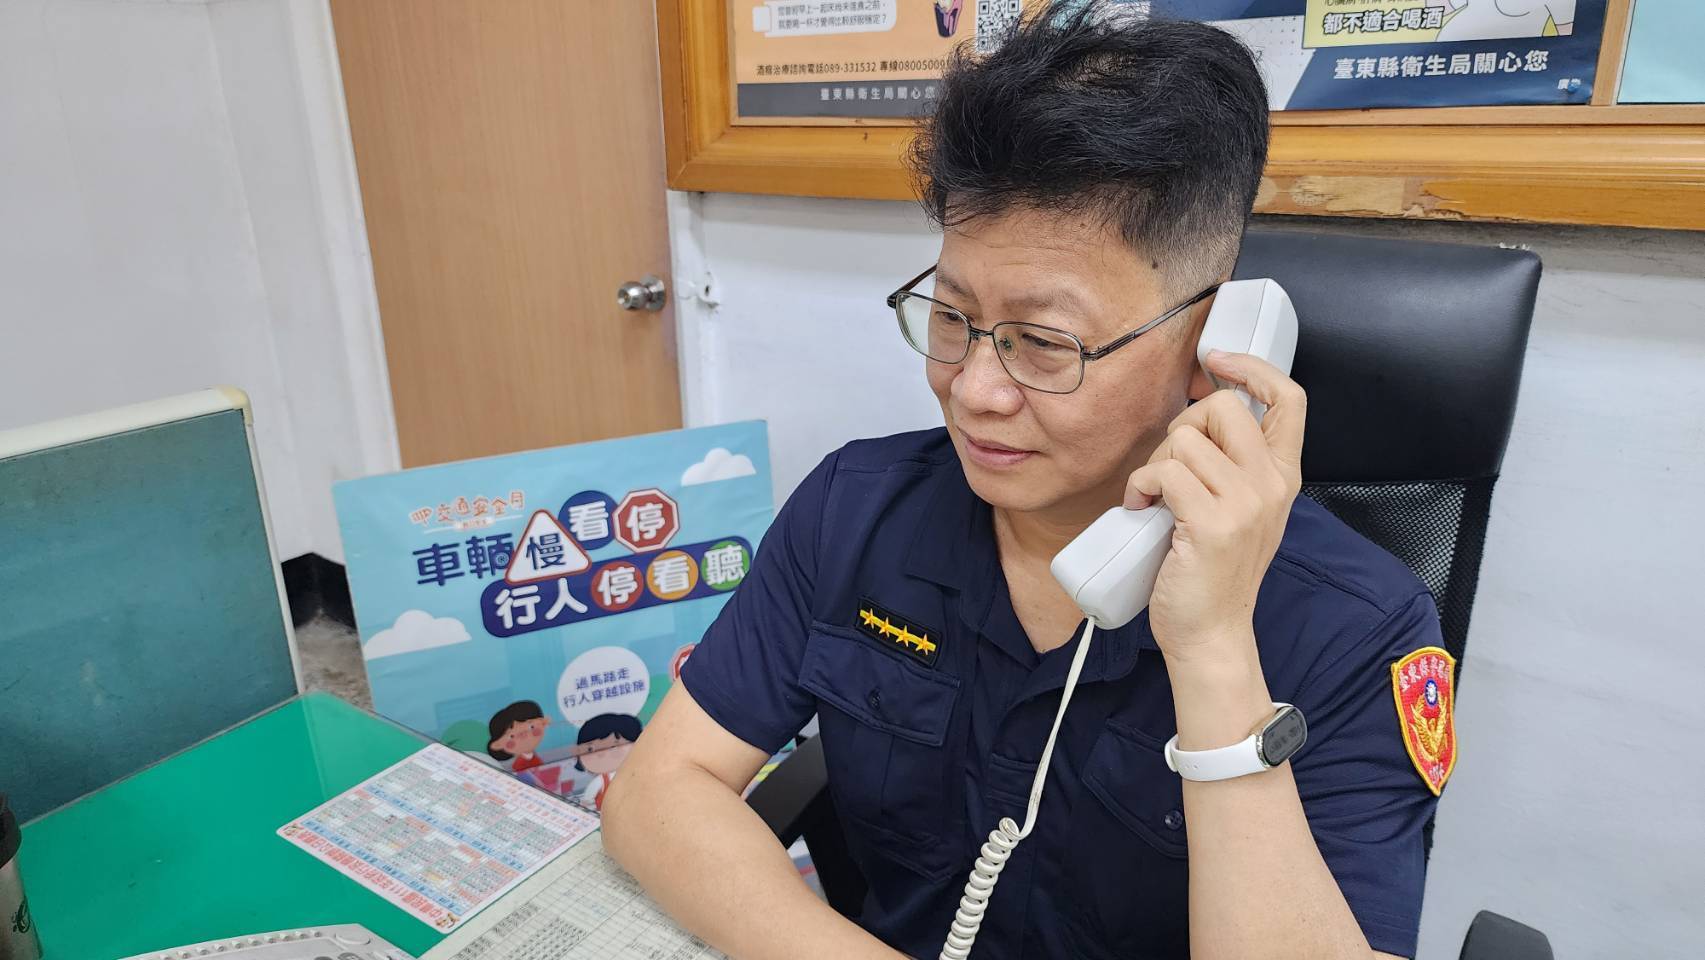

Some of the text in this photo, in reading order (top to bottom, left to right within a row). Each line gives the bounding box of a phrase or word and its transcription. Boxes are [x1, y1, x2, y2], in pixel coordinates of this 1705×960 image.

[1323, 6, 1445, 35] 都不適合喝酒
[1334, 50, 1549, 80] 臺東縣衛生局關心您
[576, 667, 631, 690] 過馬路走
[564, 680, 645, 707] 行人穿越設施
